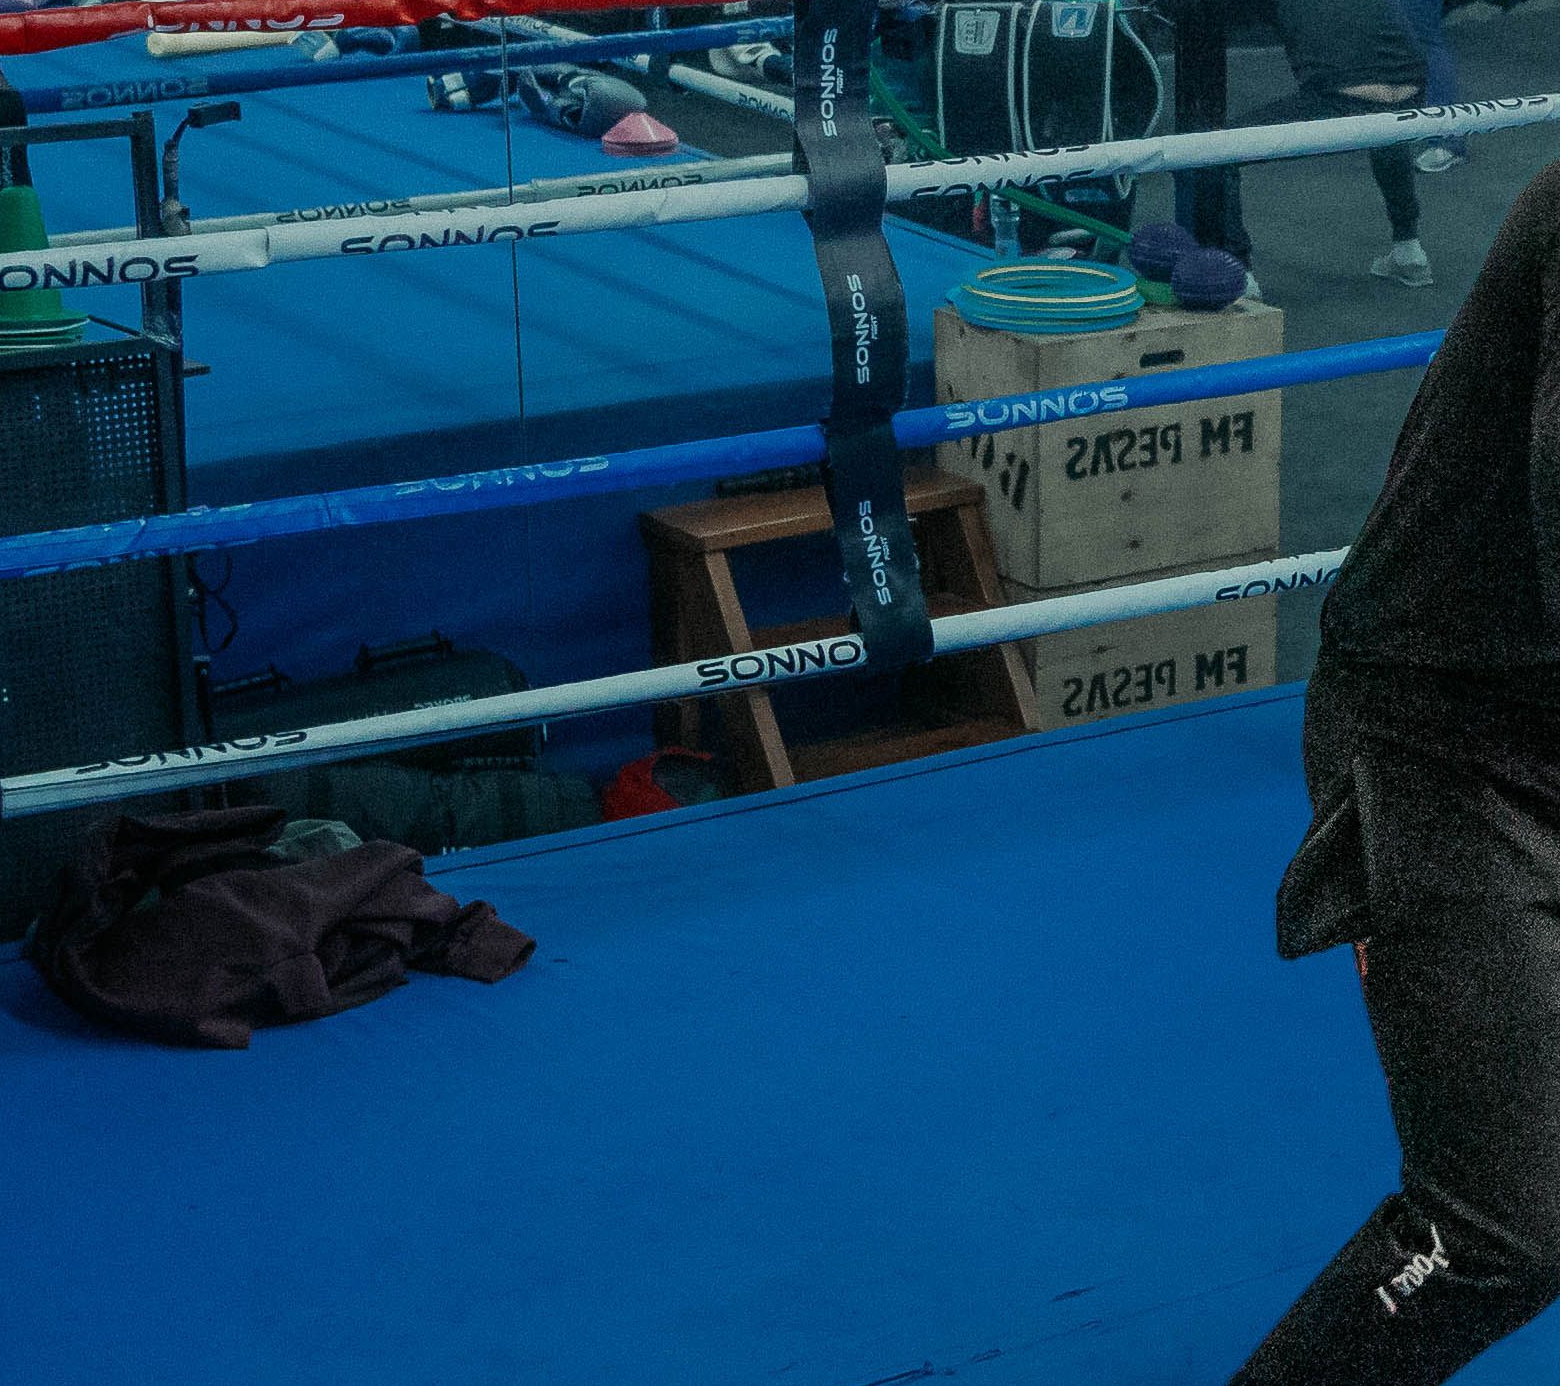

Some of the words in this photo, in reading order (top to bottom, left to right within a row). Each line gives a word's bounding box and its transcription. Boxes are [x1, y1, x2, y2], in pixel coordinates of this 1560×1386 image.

[820, 27, 838, 138] SONNOS
[847, 274, 870, 384] SONNOS
[945, 385, 1130, 430] SONNOS
[859, 500, 891, 606] SONNOS
[1215, 567, 1341, 601] SONN
[697, 635, 865, 689] SONNO
